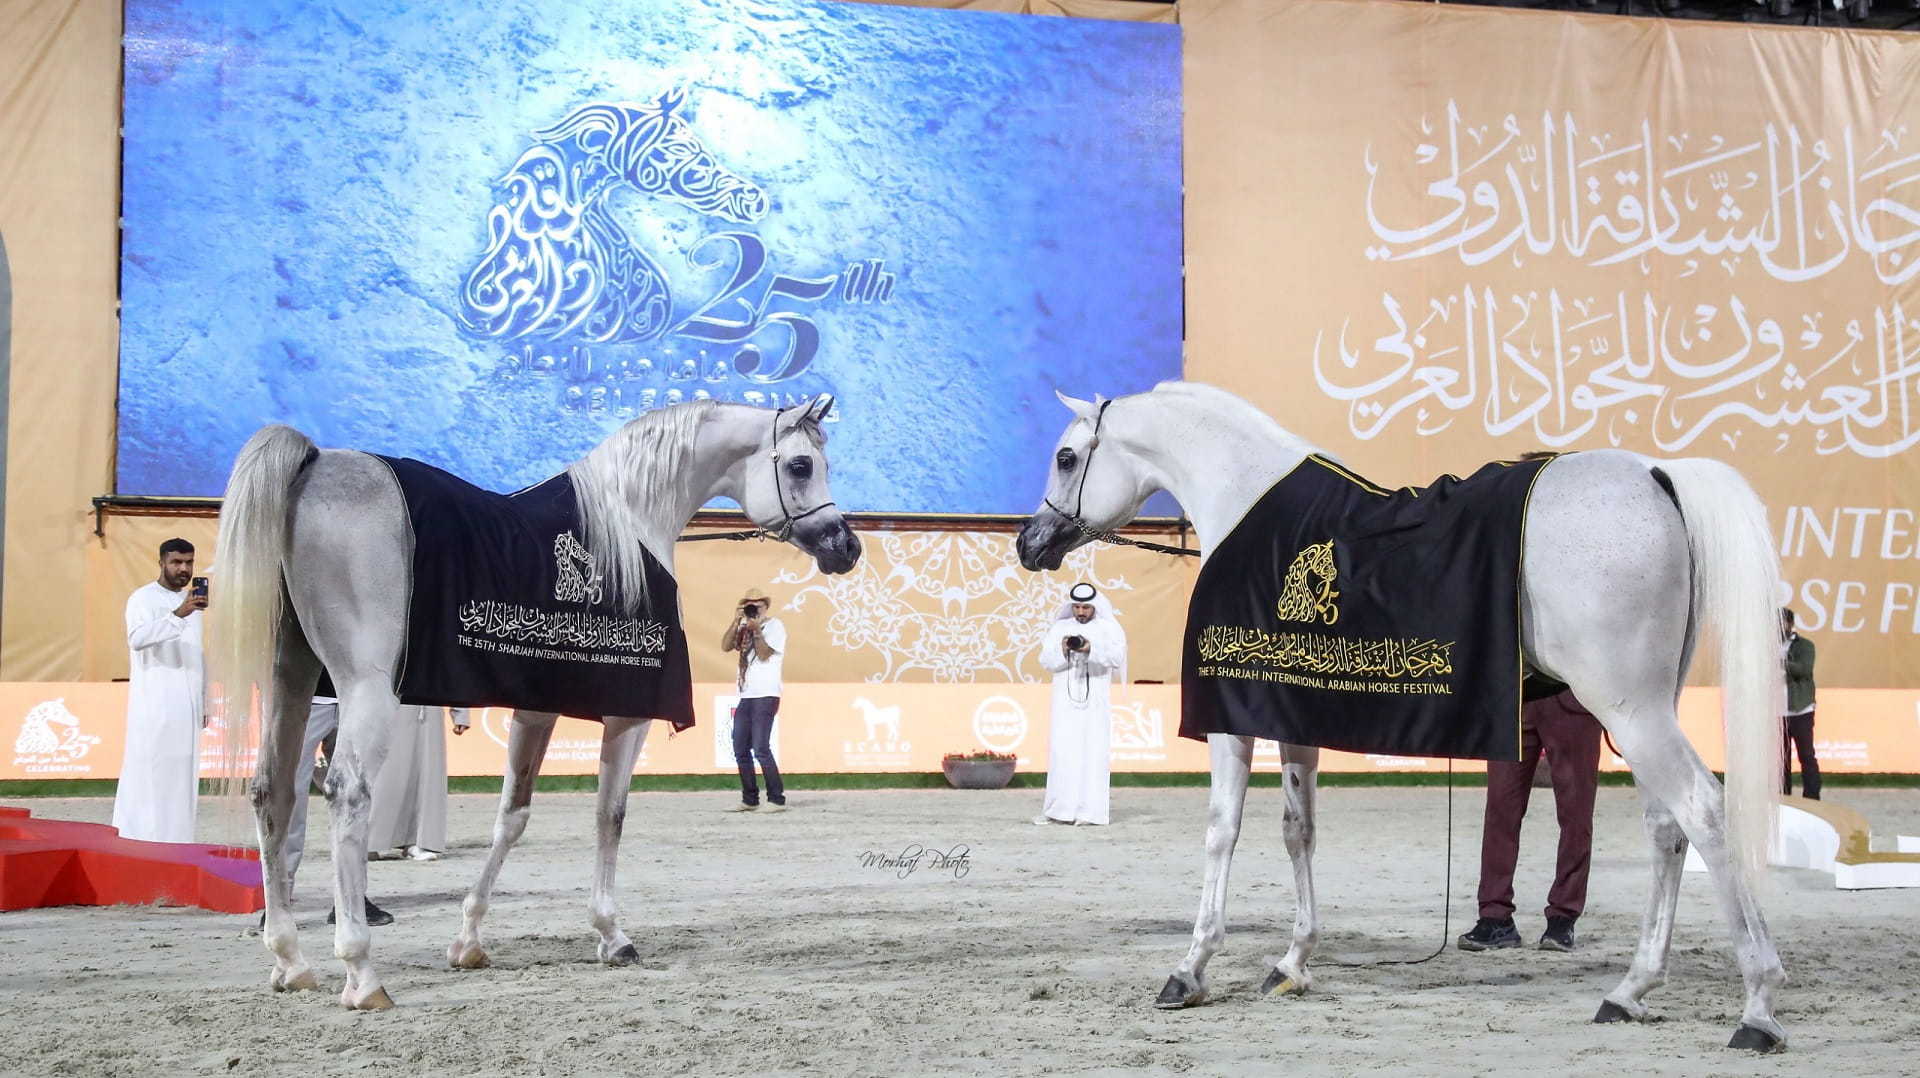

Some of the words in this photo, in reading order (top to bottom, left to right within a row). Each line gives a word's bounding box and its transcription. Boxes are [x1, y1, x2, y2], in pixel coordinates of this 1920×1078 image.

[1780, 505, 1920, 560] INTE
[458, 630, 473, 647] THE
[474, 634, 496, 652] 25TH
[498, 638, 534, 657] SHARJAH
[535, 648, 589, 663] INTERNATIONAL
[590, 654, 620, 665] ARABIAN
[620, 655, 641, 667] HORSE
[1217, 666, 1259, 680] SHARJAH
[1262, 671, 1326, 689] INTERNATIONAL
[1328, 679, 1366, 692] ARABIAN
[1368, 682, 1401, 694] HORSE
[1403, 683, 1453, 695] FESTIVAL
